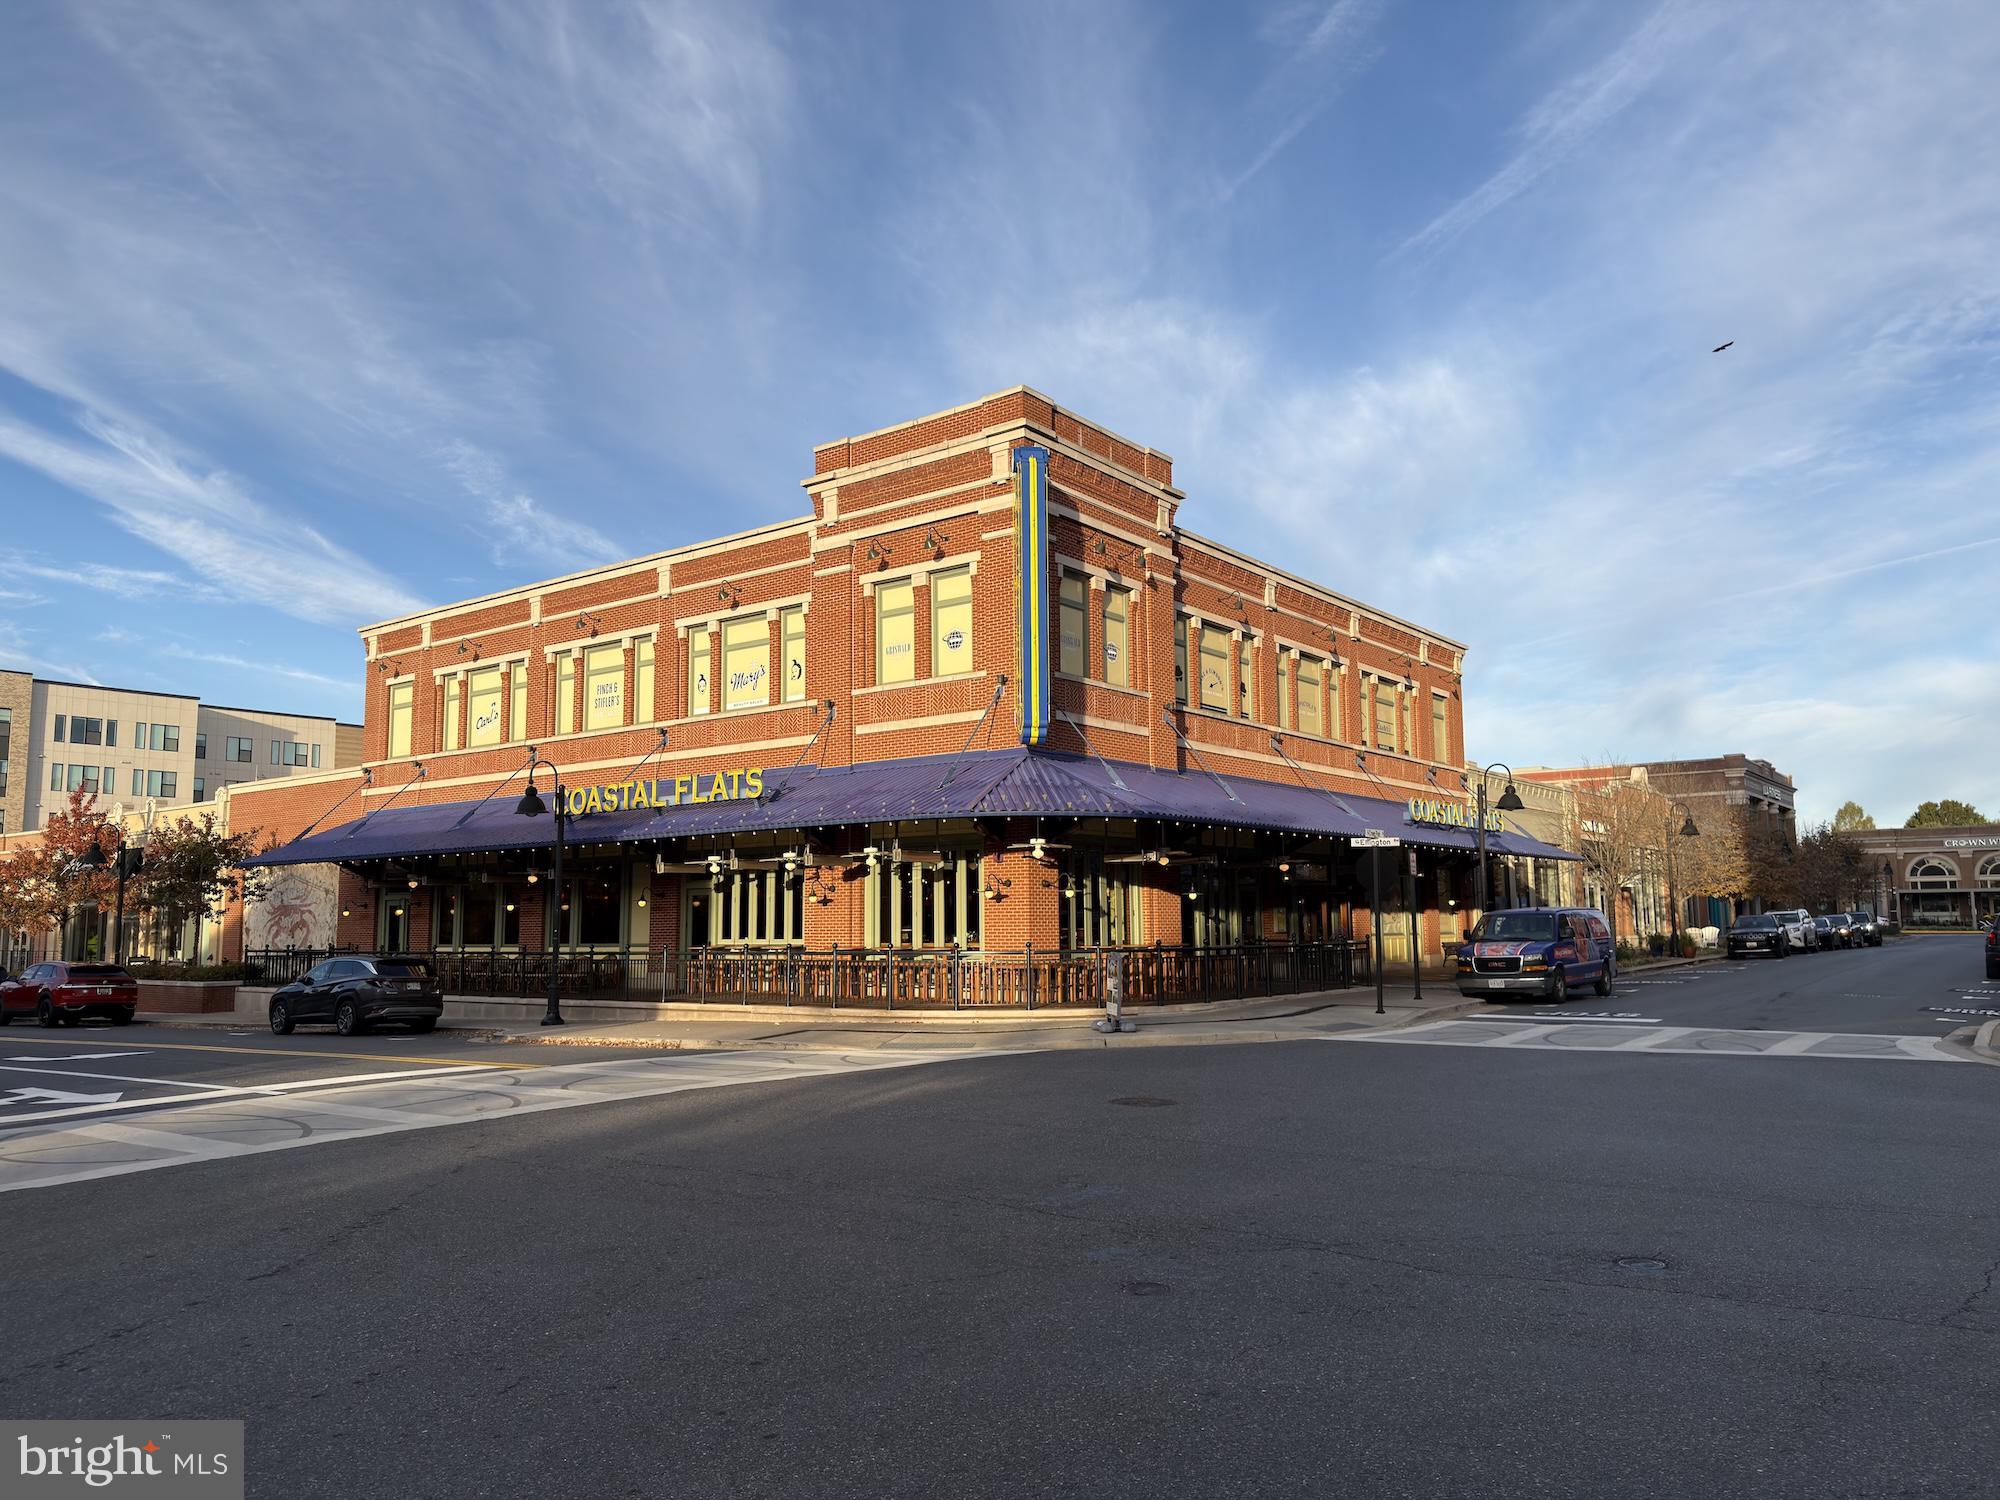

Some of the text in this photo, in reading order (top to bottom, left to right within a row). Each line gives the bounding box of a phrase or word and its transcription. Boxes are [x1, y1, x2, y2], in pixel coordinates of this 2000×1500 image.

[597, 683, 613, 695] FINCH
[731, 665, 766, 691] Mary's
[595, 695, 620, 709] STIFLER'S
[476, 708, 498, 730] Carl's
[675, 767, 764, 805] FLATS
[1410, 798, 1505, 833] COASTAL FATS
[1945, 839, 1986, 847] CROWN
